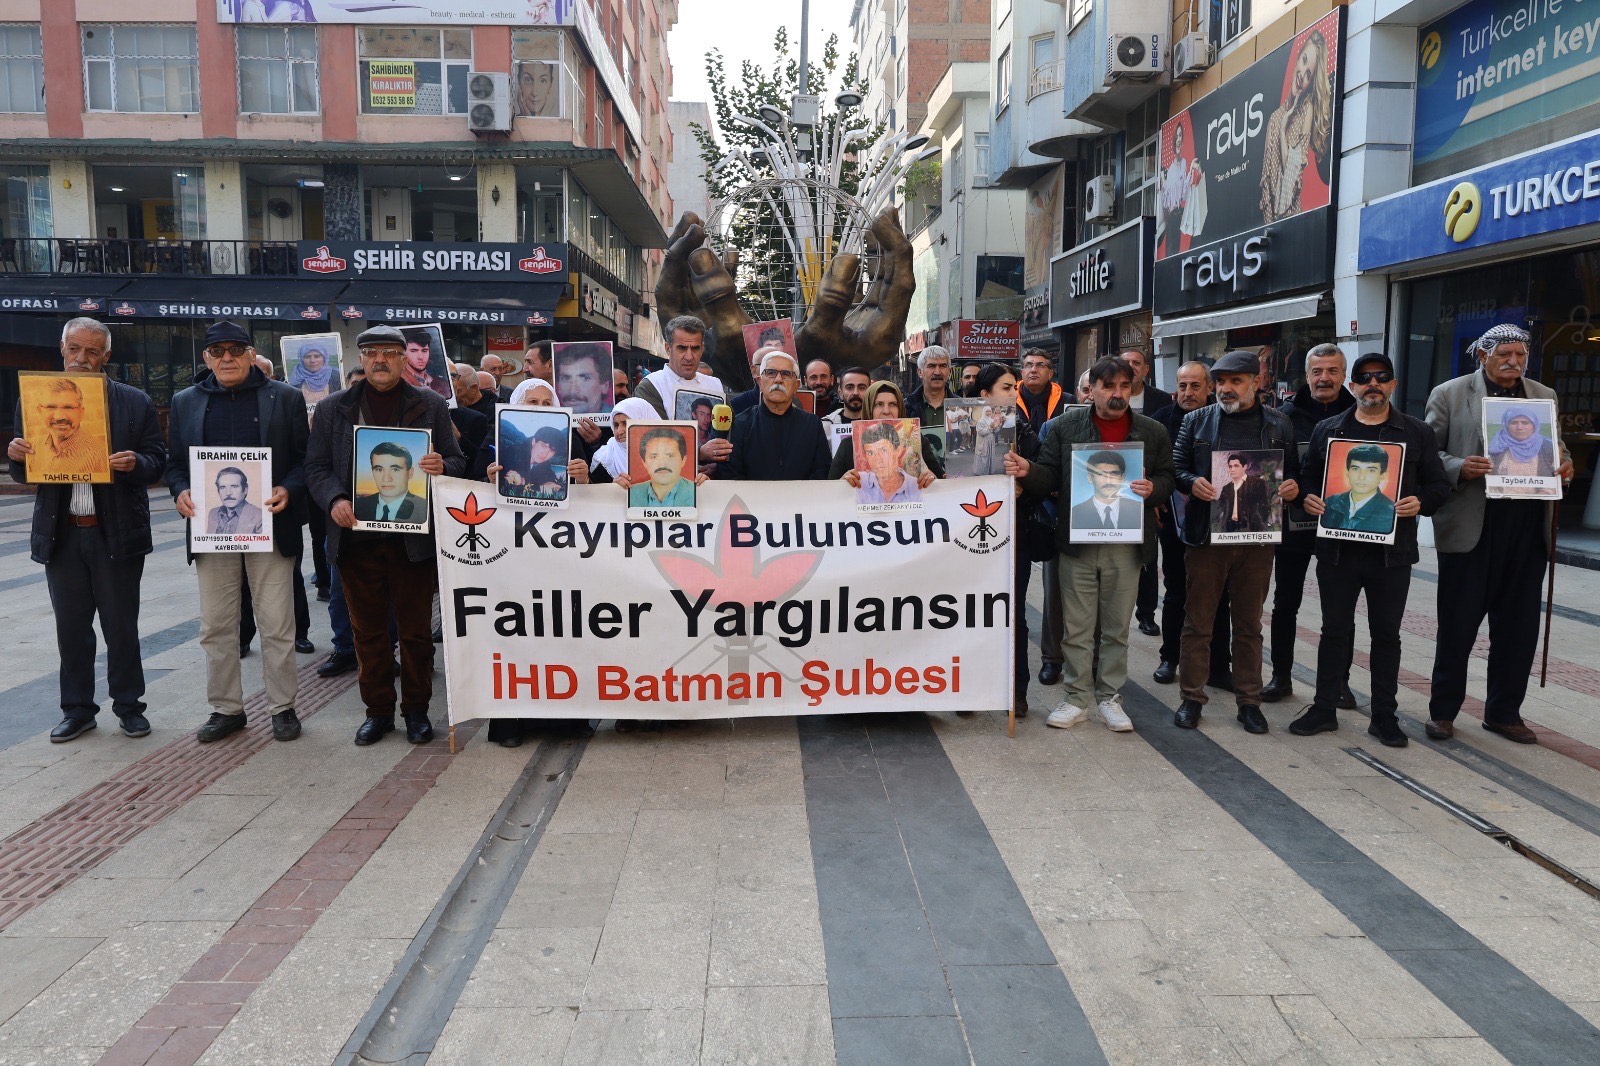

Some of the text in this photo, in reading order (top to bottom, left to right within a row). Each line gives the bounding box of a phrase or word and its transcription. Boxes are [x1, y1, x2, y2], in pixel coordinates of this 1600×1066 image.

[430, 10, 453, 20] beauty
[491, 11, 517, 19] esthetic
[1151, 34, 1159, 68] BEKO
[371, 63, 413, 75] SAHİBİNDEN
[1456, 36, 1546, 100] internet
[387, 97, 397, 105] 553
[1206, 92, 1264, 160] rays
[308, 259, 341, 271] şenpiliç
[353, 244, 511, 274] ŞEHİR SOFRASI
[1181, 236, 1262, 293] rays
[524, 260, 557, 272] şenpiliç
[1069, 248, 1110, 299] stilife
[159, 303, 279, 316] ŞEHİR SOFRASI
[385, 307, 505, 321] ŞEHİR SOFRASI
[970, 323, 1008, 336] Şirin
[962, 335, 1016, 345] Collection
[197, 449, 268, 461] İBRAHİM ÇELİK
[43, 473, 91, 482] TAHİR ELÇİ
[1501, 477, 1526, 485] Taybet
[643, 509, 682, 518] İSA GÖK
[394, 523, 422, 531] SAÇAN
[514, 511, 950, 559] Kayıplar Bulunsun
[1242, 533, 1273, 541] YETİŞEN
[1358, 533, 1386, 541] MALTU
[453, 586, 1010, 648] Failler Yargılansın
[492, 653, 961, 706] İHD Batman Şubesi
